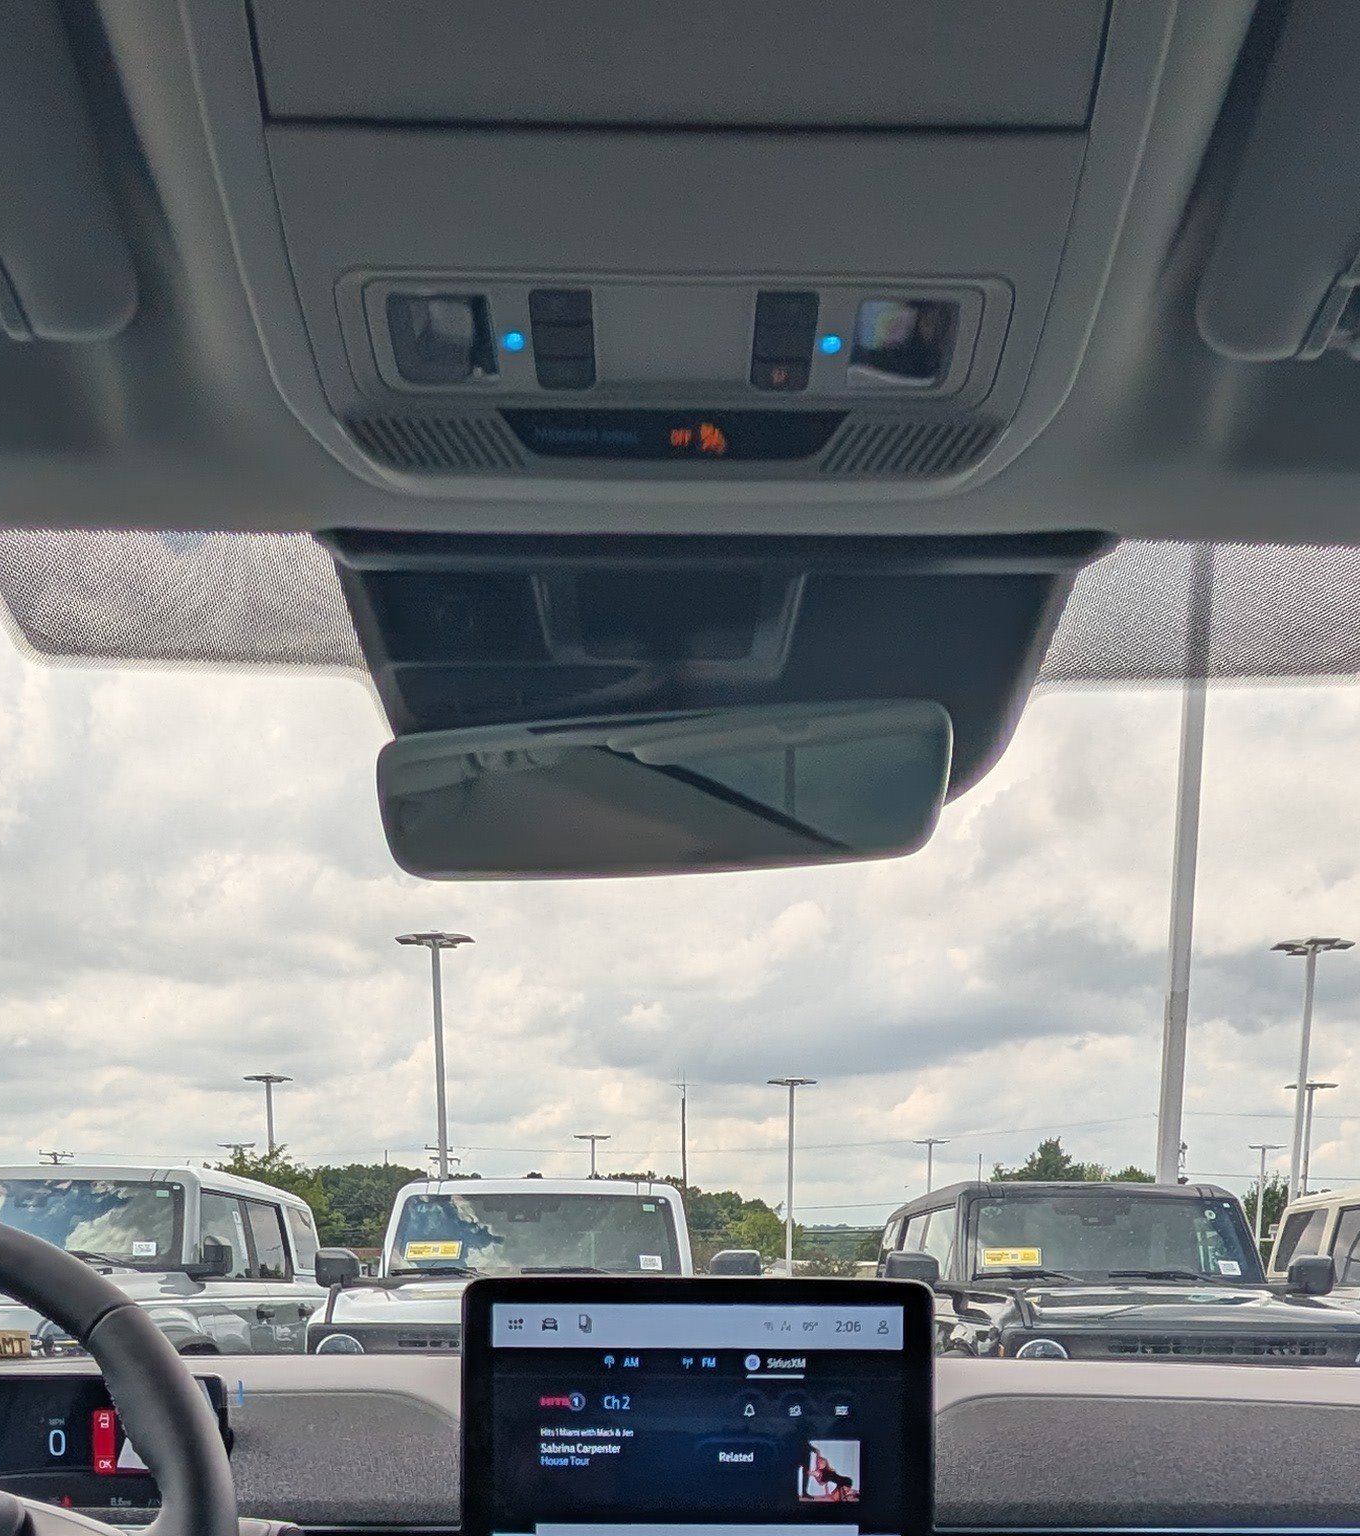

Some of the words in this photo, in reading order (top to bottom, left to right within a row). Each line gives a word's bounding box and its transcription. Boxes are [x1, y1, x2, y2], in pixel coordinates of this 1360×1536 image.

[835, 1320, 861, 1332] 2:06
[623, 1357, 639, 1368] AM
[701, 1357, 716, 1368] FM
[603, 1396, 620, 1410] Ch
[622, 1396, 631, 1410] 2
[48, 1429, 66, 1457] 0
[540, 1443, 575, 1454] Sabrina
[576, 1443, 621, 1455] Carpenter
[540, 1456, 568, 1466] House
[570, 1457, 590, 1466] Tour
[719, 1451, 754, 1462] Related
